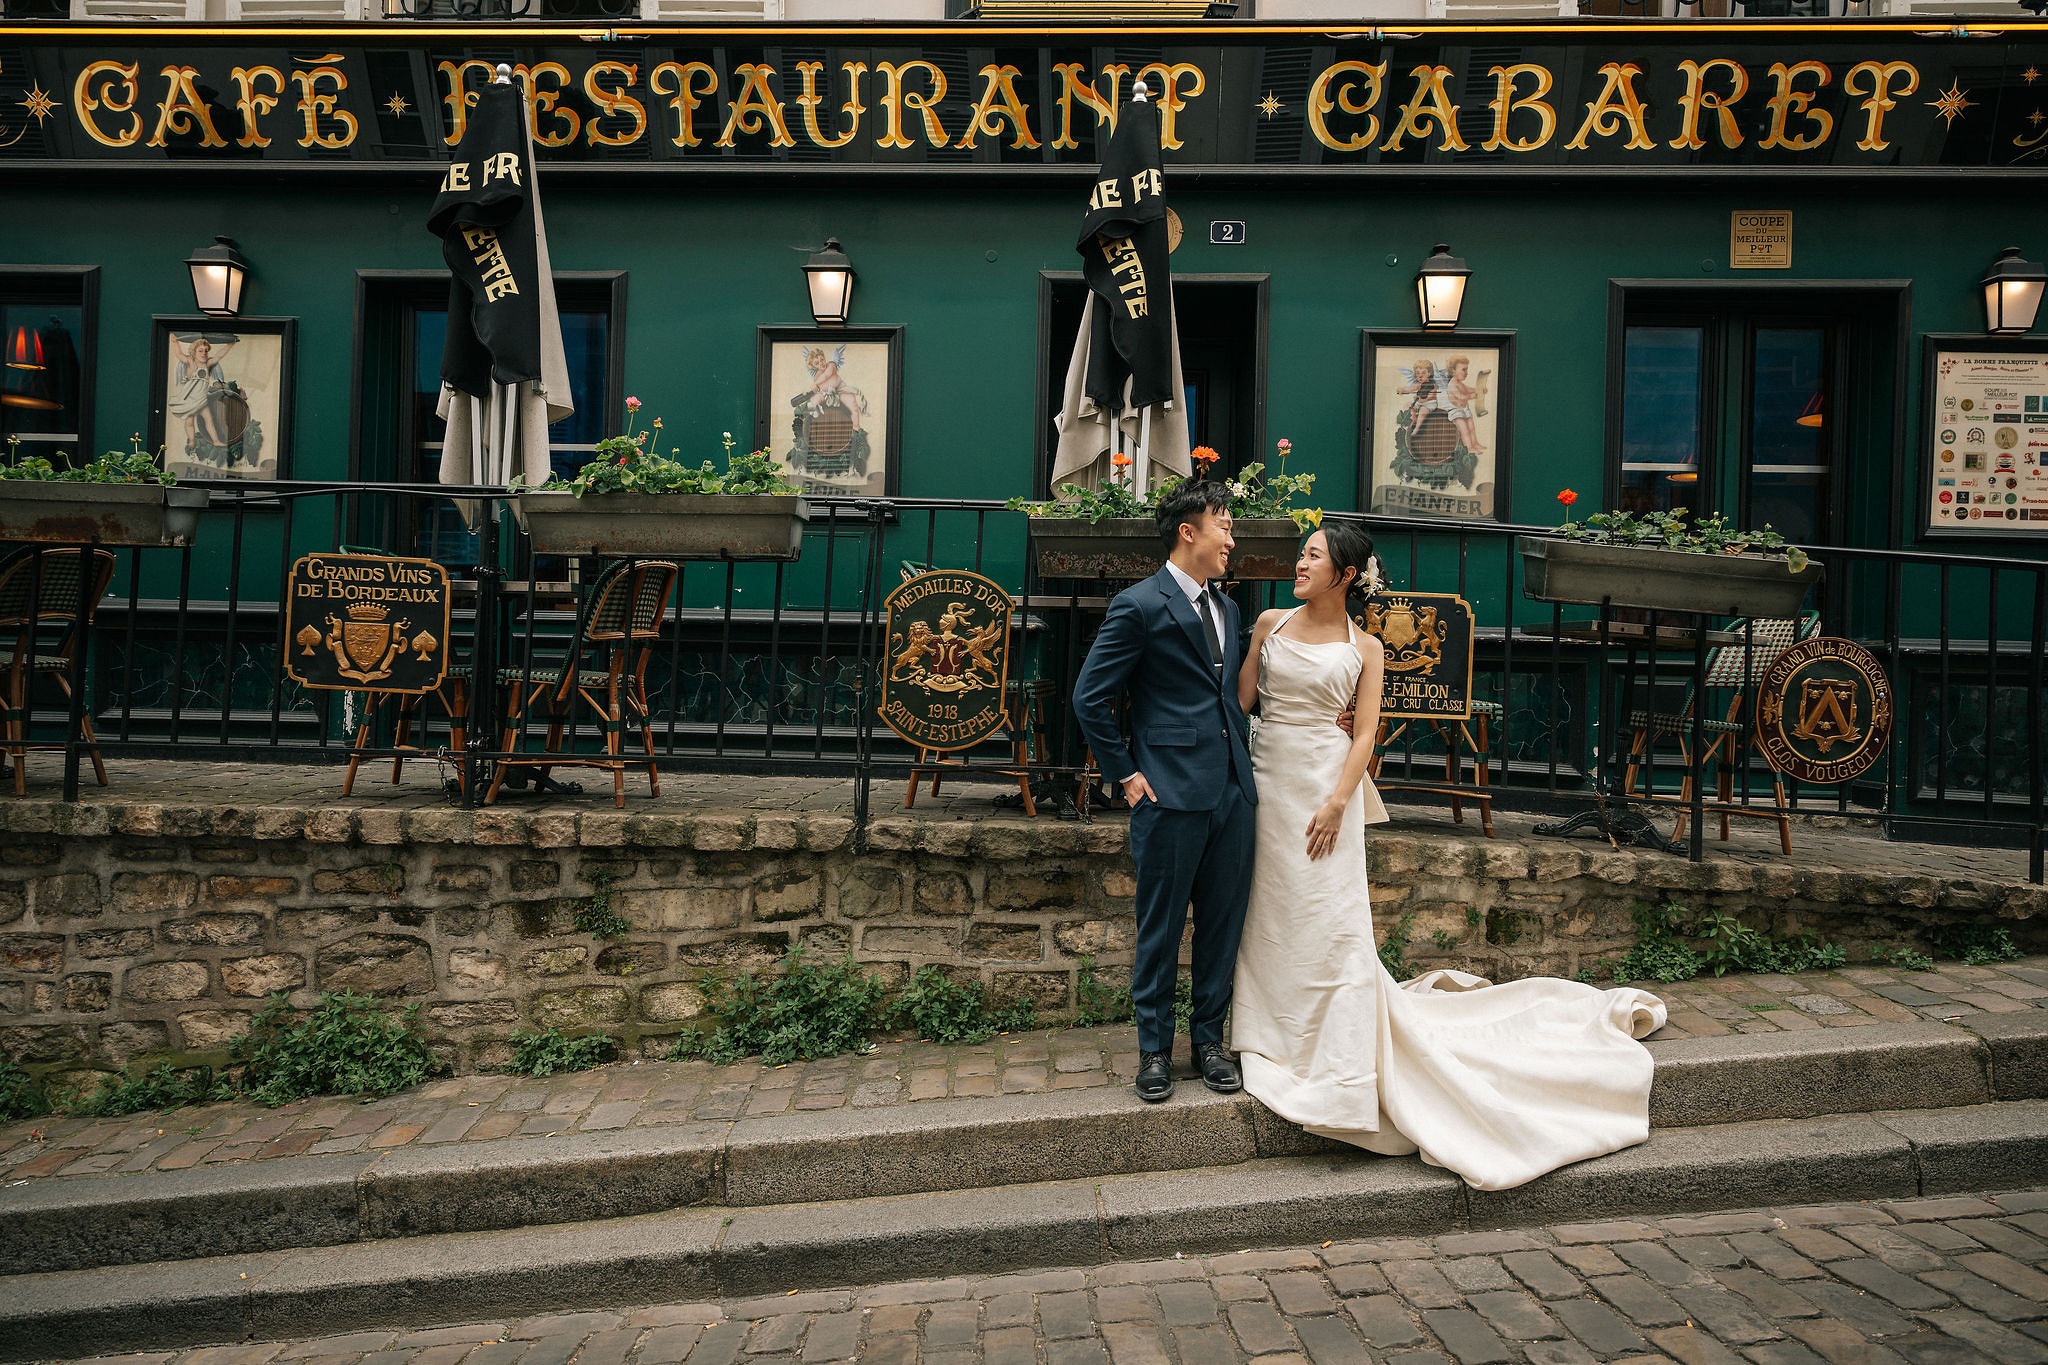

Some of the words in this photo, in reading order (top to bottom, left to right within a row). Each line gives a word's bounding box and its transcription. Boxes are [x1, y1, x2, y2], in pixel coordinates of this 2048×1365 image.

[74, 54, 358, 148] CAFÉ
[1307, 58, 1921, 152] CABARET
[1222, 224, 1234, 241] 2
[1739, 216, 1785, 227] COUPE
[1736, 235, 1786, 243] MEILLEUR
[458, 222, 520, 304] ETTE
[1096, 232, 1149, 320] ETTE
[1385, 487, 1483, 516] CHANTER
[307, 558, 385, 583] GRANDS
[387, 562, 432, 585] VINS
[297, 583, 324, 599] DE
[327, 579, 440, 604] BORDEAUX
[893, 578, 974, 614] MÉDAILLES
[973, 585, 1006, 617] D'OR
[1769, 649, 1805, 685] GRAND
[1804, 641, 1825, 657] VIN
[1825, 641, 1836, 655] de
[1837, 642, 1888, 696] BOURGOGNE
[1381, 682, 1450, 699] T-EMILION
[927, 703, 958, 720] 1918
[1402, 698, 1422, 709] CRU
[1428, 699, 1465, 712] CLASSE
[887, 700, 999, 743] SAINT-ESTÈPHE
[1767, 737, 1800, 771] CLOS
[1805, 747, 1874, 781] VOUGEOT
